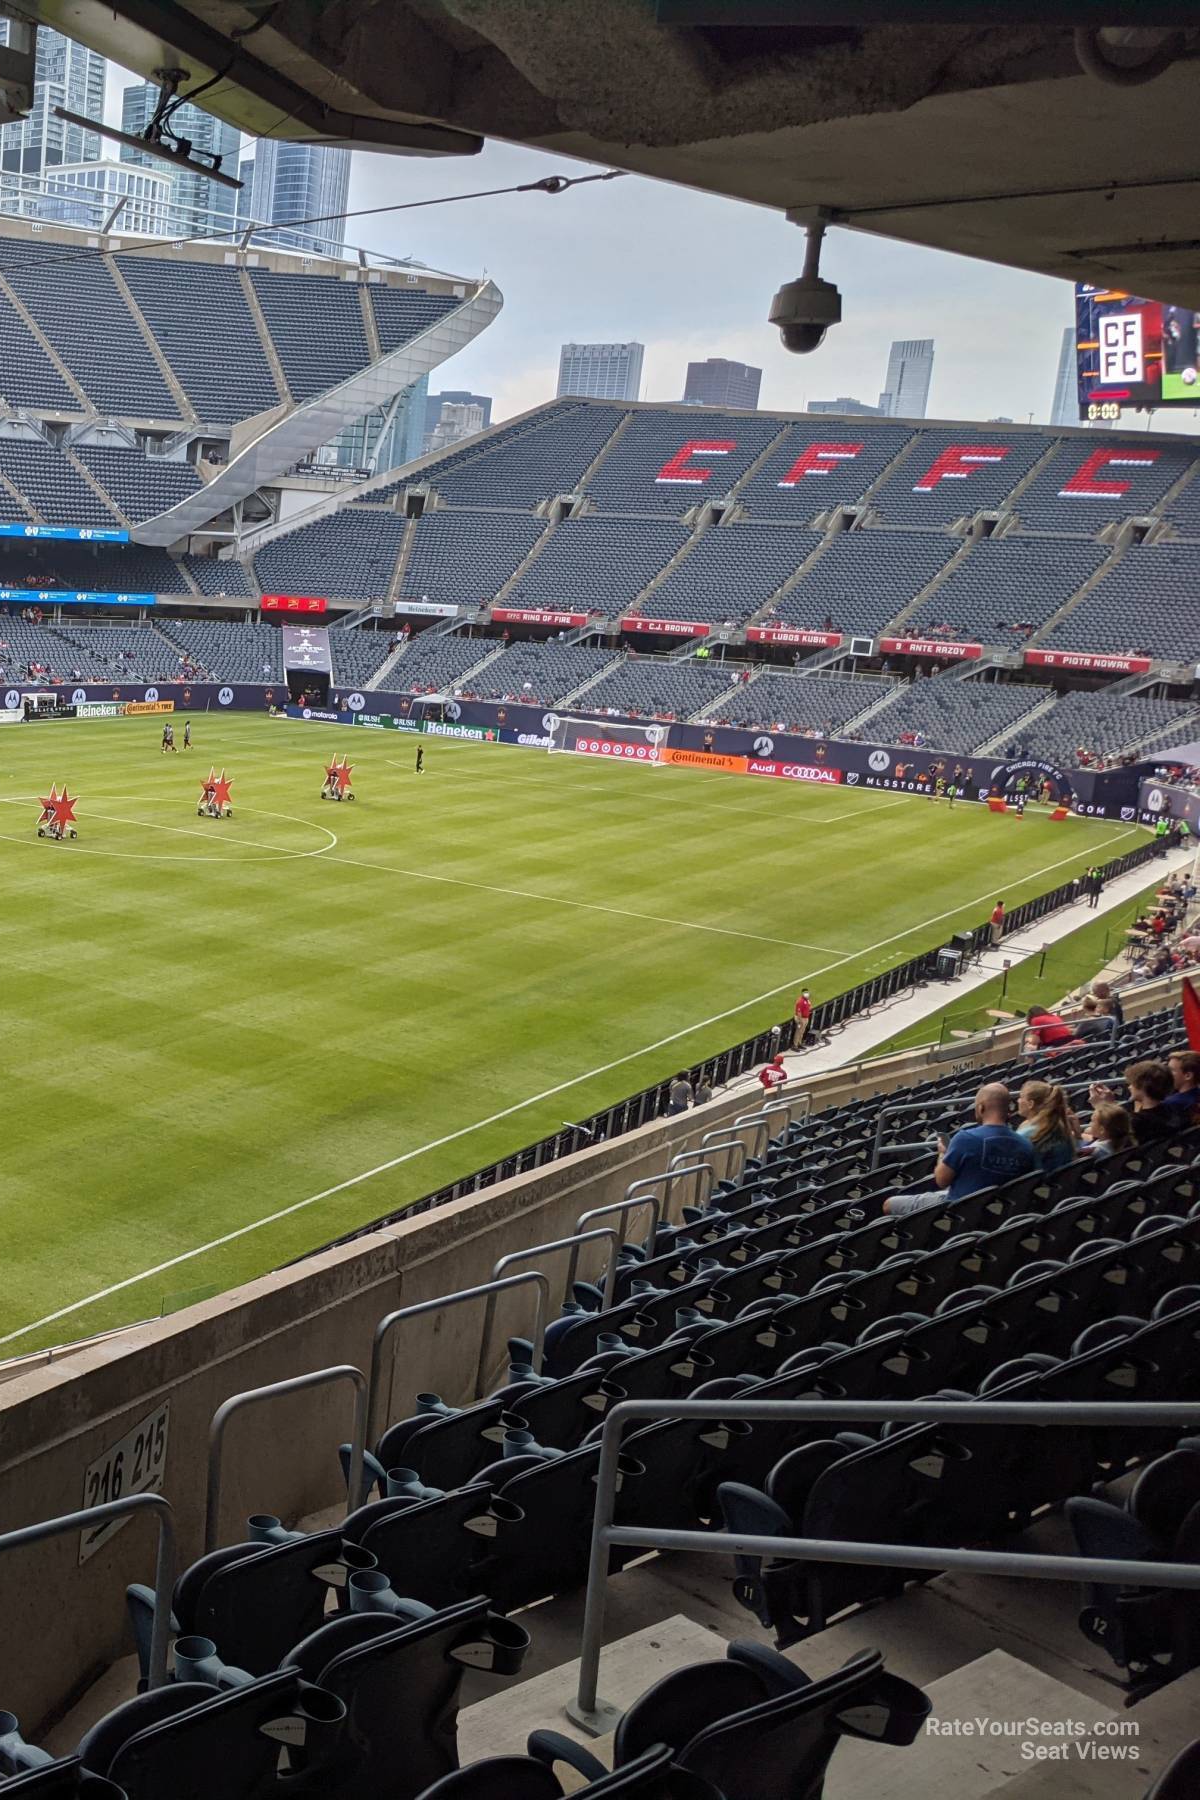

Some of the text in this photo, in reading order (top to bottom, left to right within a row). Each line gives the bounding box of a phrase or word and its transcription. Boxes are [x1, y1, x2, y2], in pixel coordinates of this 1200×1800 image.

[1104, 320, 1136, 347] CF
[1104, 350, 1137, 377] FC
[1087, 403, 1119, 419] 0:00
[522, 613, 541, 622] RING
[542, 615, 553, 623] OF
[554, 615, 571, 624] FIRE
[636, 621, 694, 633] 2 C.J. BROWN
[909, 644, 934, 653] ANTE
[935, 645, 965, 656] RAZOV
[1044, 655, 1130, 670] 10 PIOTR NOWAK
[76, 705, 117, 717] Heineken
[311, 711, 338, 720] motorola
[427, 722, 483, 739] Heineken
[671, 750, 726, 766] Continental
[750, 762, 776, 774] Audi
[1006, 761, 1037, 773] CHICAGO
[1037, 762, 1054, 772] FIRE
[87, 1417, 166, 1505] 216 215
[743, 1585, 754, 1600] 11
[1092, 1617, 1107, 1634] 12
